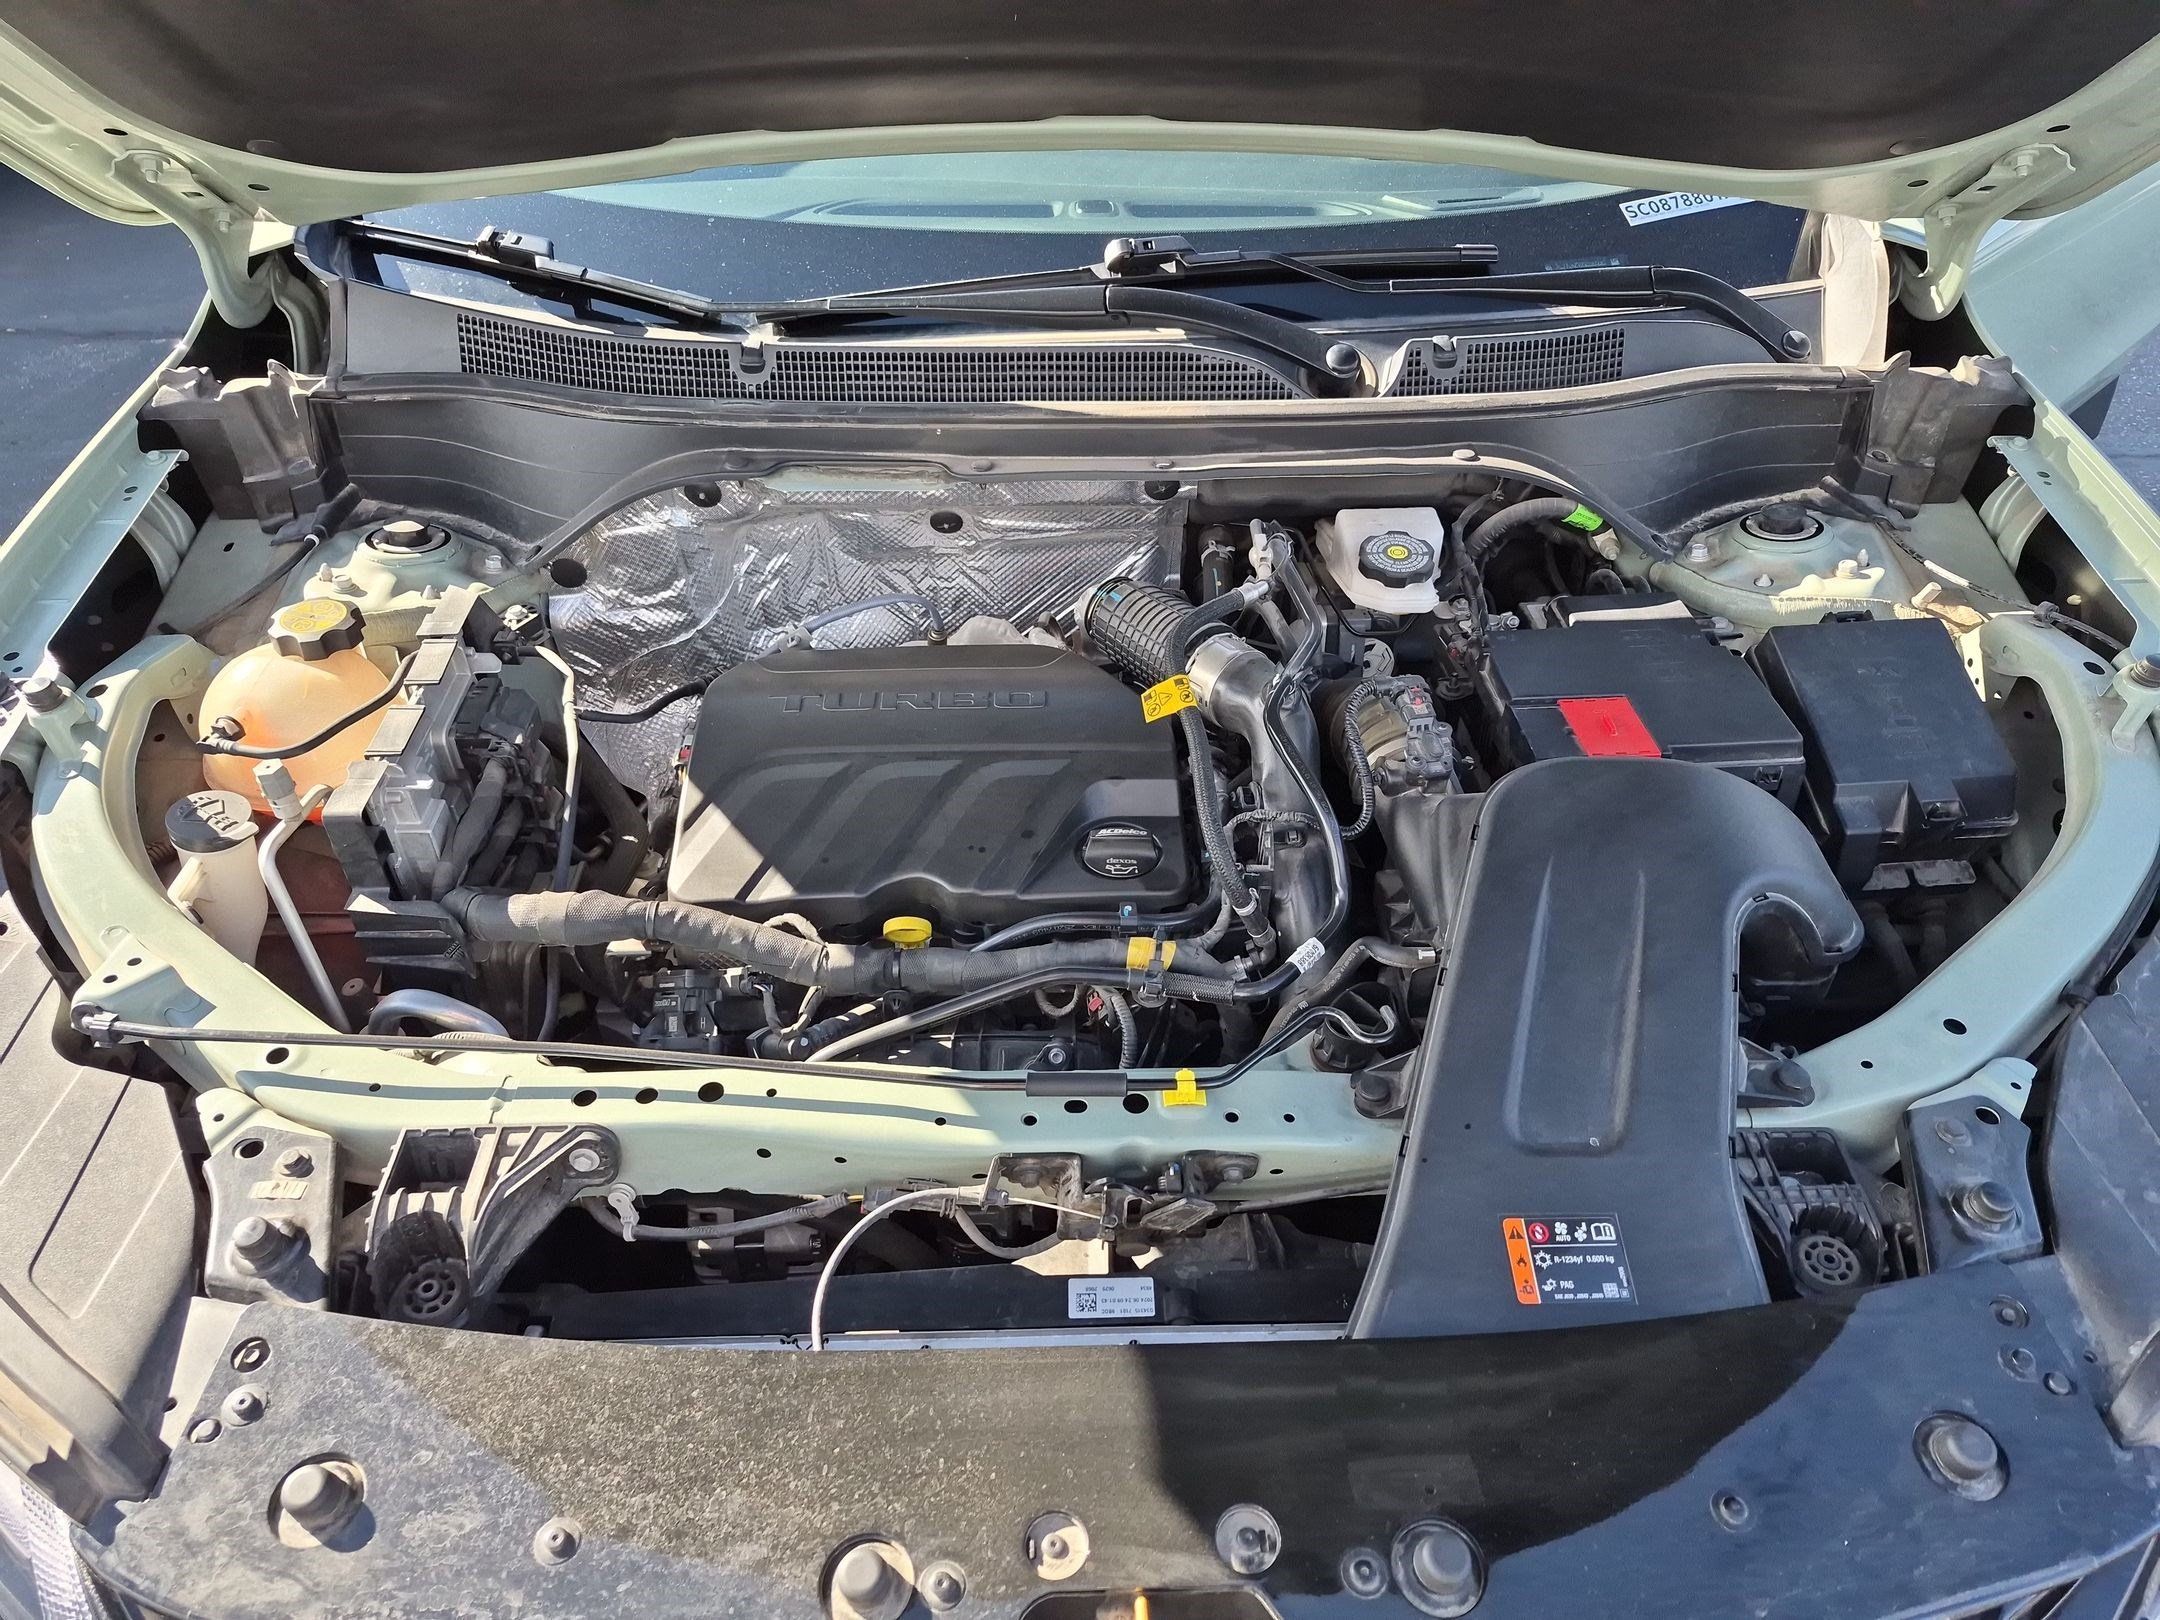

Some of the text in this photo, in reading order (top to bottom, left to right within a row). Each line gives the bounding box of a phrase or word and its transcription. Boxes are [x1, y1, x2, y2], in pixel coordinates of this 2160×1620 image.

[768, 690, 1048, 713] TURBO
[1095, 828, 1148, 837] ACDelco
[1555, 1234, 1571, 1242] AUTO
[1554, 1255, 1583, 1265] R-1234yf
[1559, 1280, 1575, 1289] PAG
